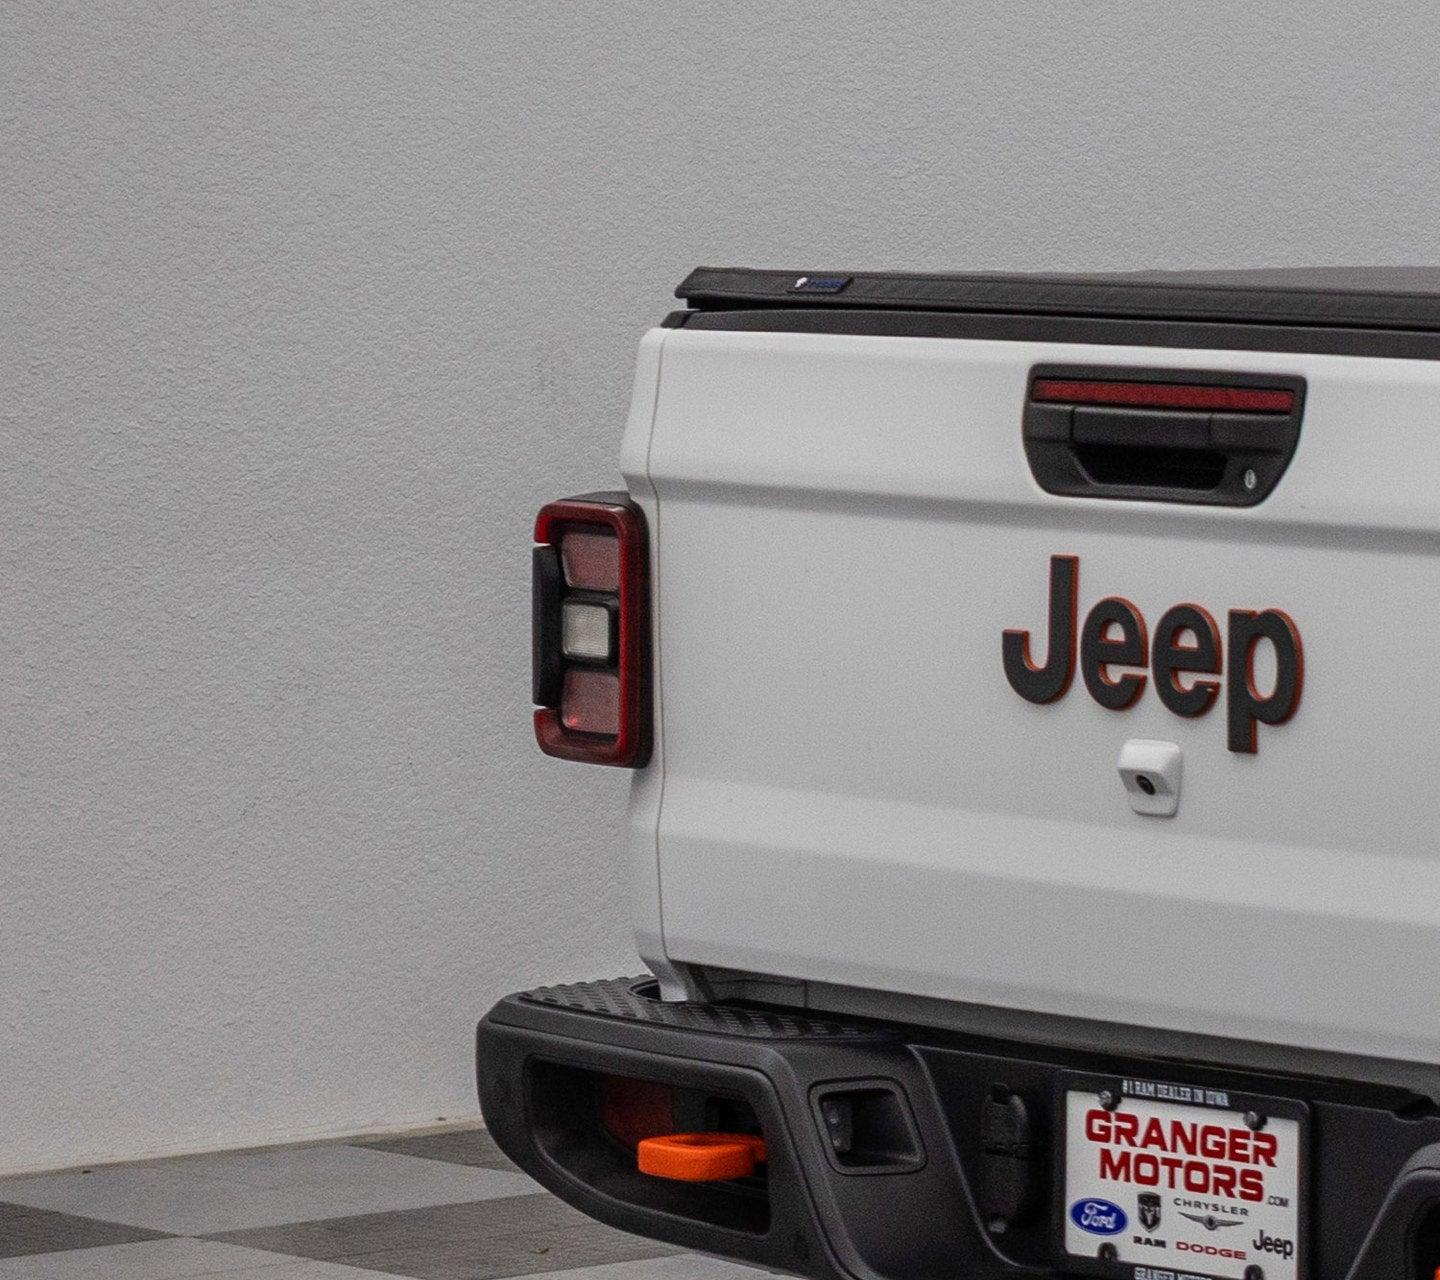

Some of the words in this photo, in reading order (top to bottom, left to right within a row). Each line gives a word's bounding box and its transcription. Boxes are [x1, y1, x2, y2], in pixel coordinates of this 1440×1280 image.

[1002, 554, 1304, 754] Jeep
[1135, 1081, 1155, 1097] RAM
[1157, 1084, 1192, 1102] DEALER
[1085, 1108, 1278, 1168] GRANGER
[1099, 1147, 1264, 1202] MOTORS
[1081, 1202, 1117, 1229] Ford
[1173, 1197, 1249, 1216] CHRYSLER
[1133, 1236, 1166, 1248] RAM
[1176, 1241, 1248, 1260] DODGE
[1252, 1228, 1294, 1260] Jeep
